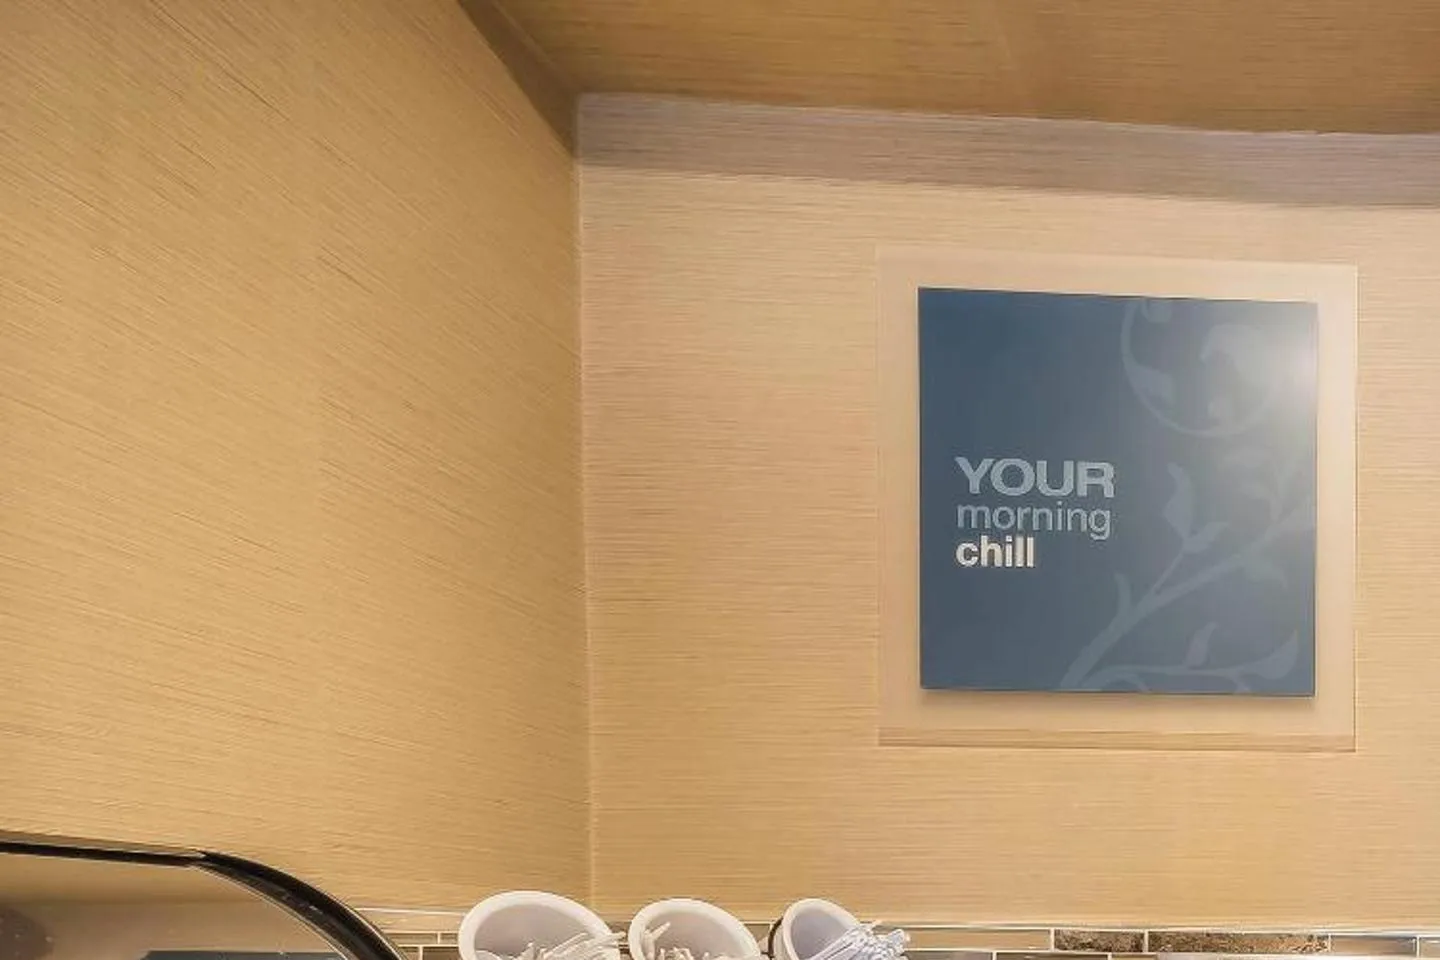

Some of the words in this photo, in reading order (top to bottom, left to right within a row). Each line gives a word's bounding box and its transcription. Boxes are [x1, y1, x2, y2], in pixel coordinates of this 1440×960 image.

[954, 456, 1116, 498] YOUR
[957, 500, 1111, 541] morning
[956, 535, 1035, 568] chill
